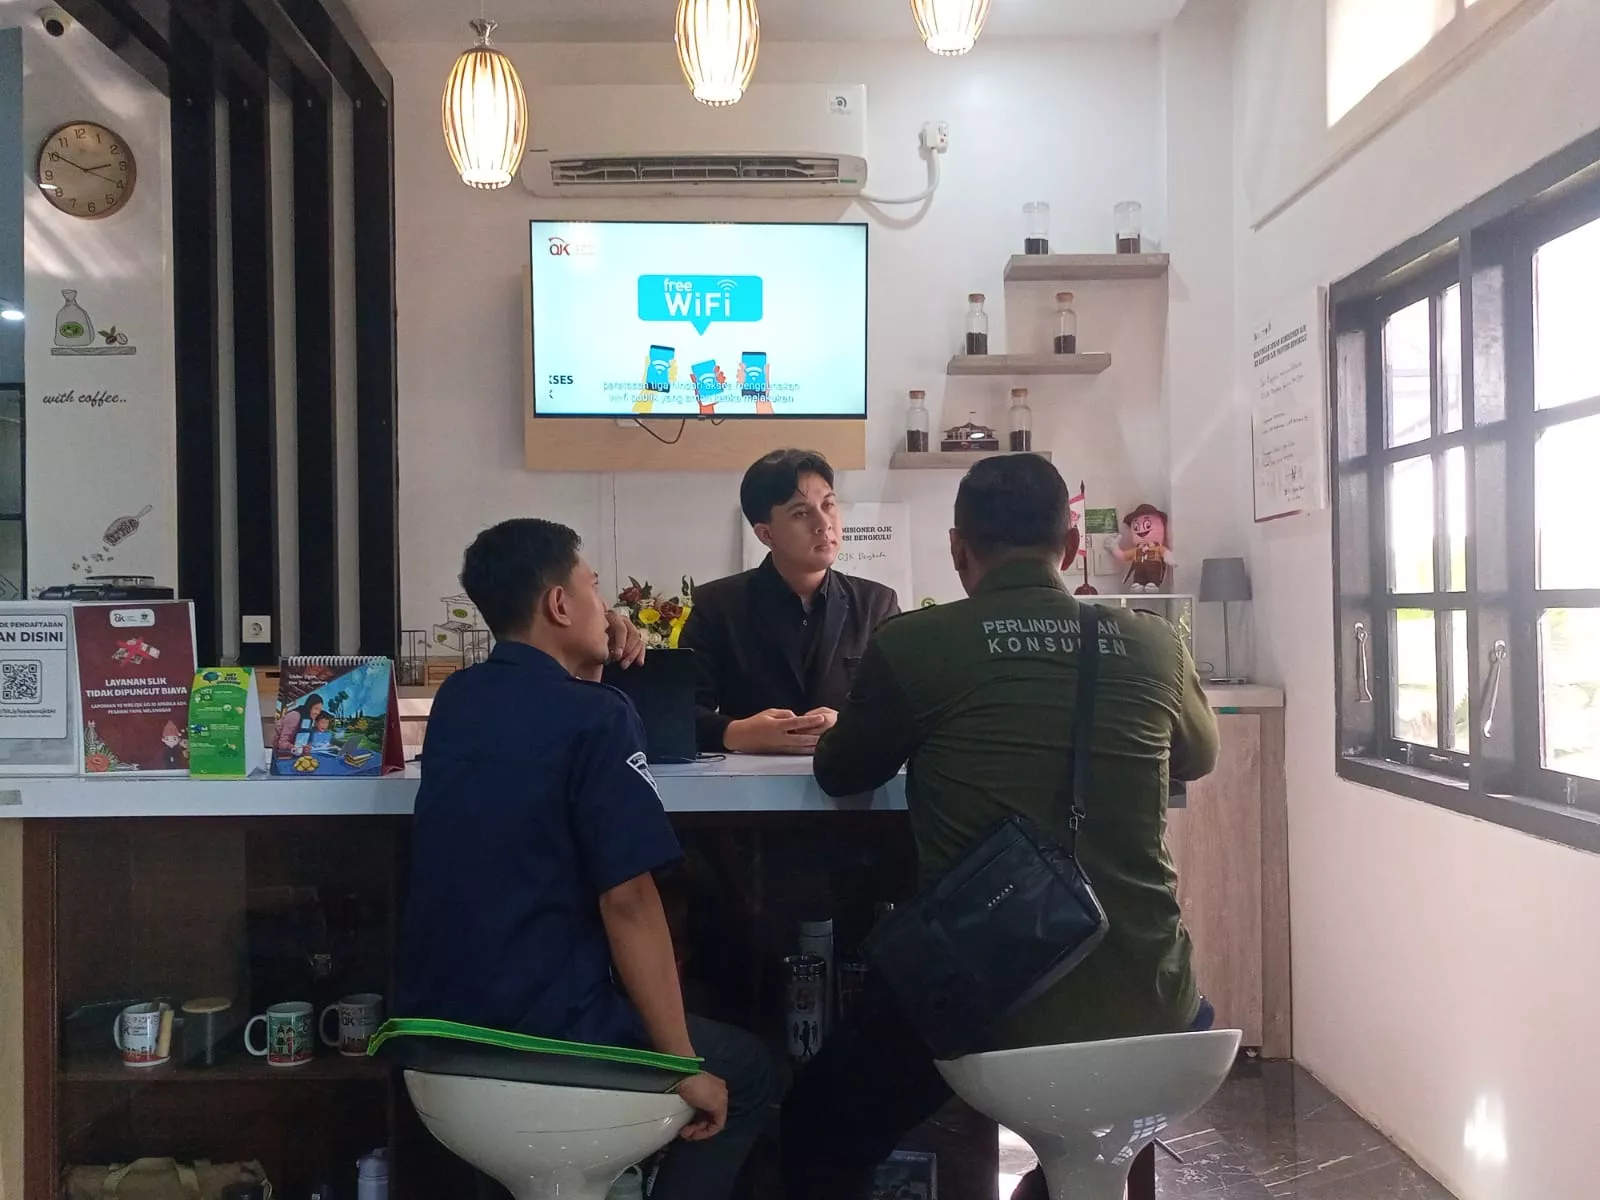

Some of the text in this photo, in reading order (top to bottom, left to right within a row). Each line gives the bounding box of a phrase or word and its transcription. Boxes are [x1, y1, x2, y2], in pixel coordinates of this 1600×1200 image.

[74, 128, 86, 139] 12
[96, 133, 102, 144] 1
[58, 137, 69, 147] 11
[110, 144, 119, 155] 2
[48, 151, 60, 162] 10
[44, 170, 54, 181] 9
[116, 179, 124, 189] 4
[55, 187, 63, 198] 8
[68, 198, 77, 208] 7
[105, 194, 114, 205] 5
[87, 202, 96, 213] 6
[663, 277, 693, 293] free
[664, 291, 731, 317] WiFi
[42, 389, 75, 404] with
[982, 619, 1121, 635] PERLINDUNAN
[20, 631, 64, 642] DISINI
[987, 636, 1127, 656] KONSUEN
[105, 677, 168, 687] LAYANAN SLIK
[86, 687, 188, 697] TIDAK DIPUNGUT BIAYA
